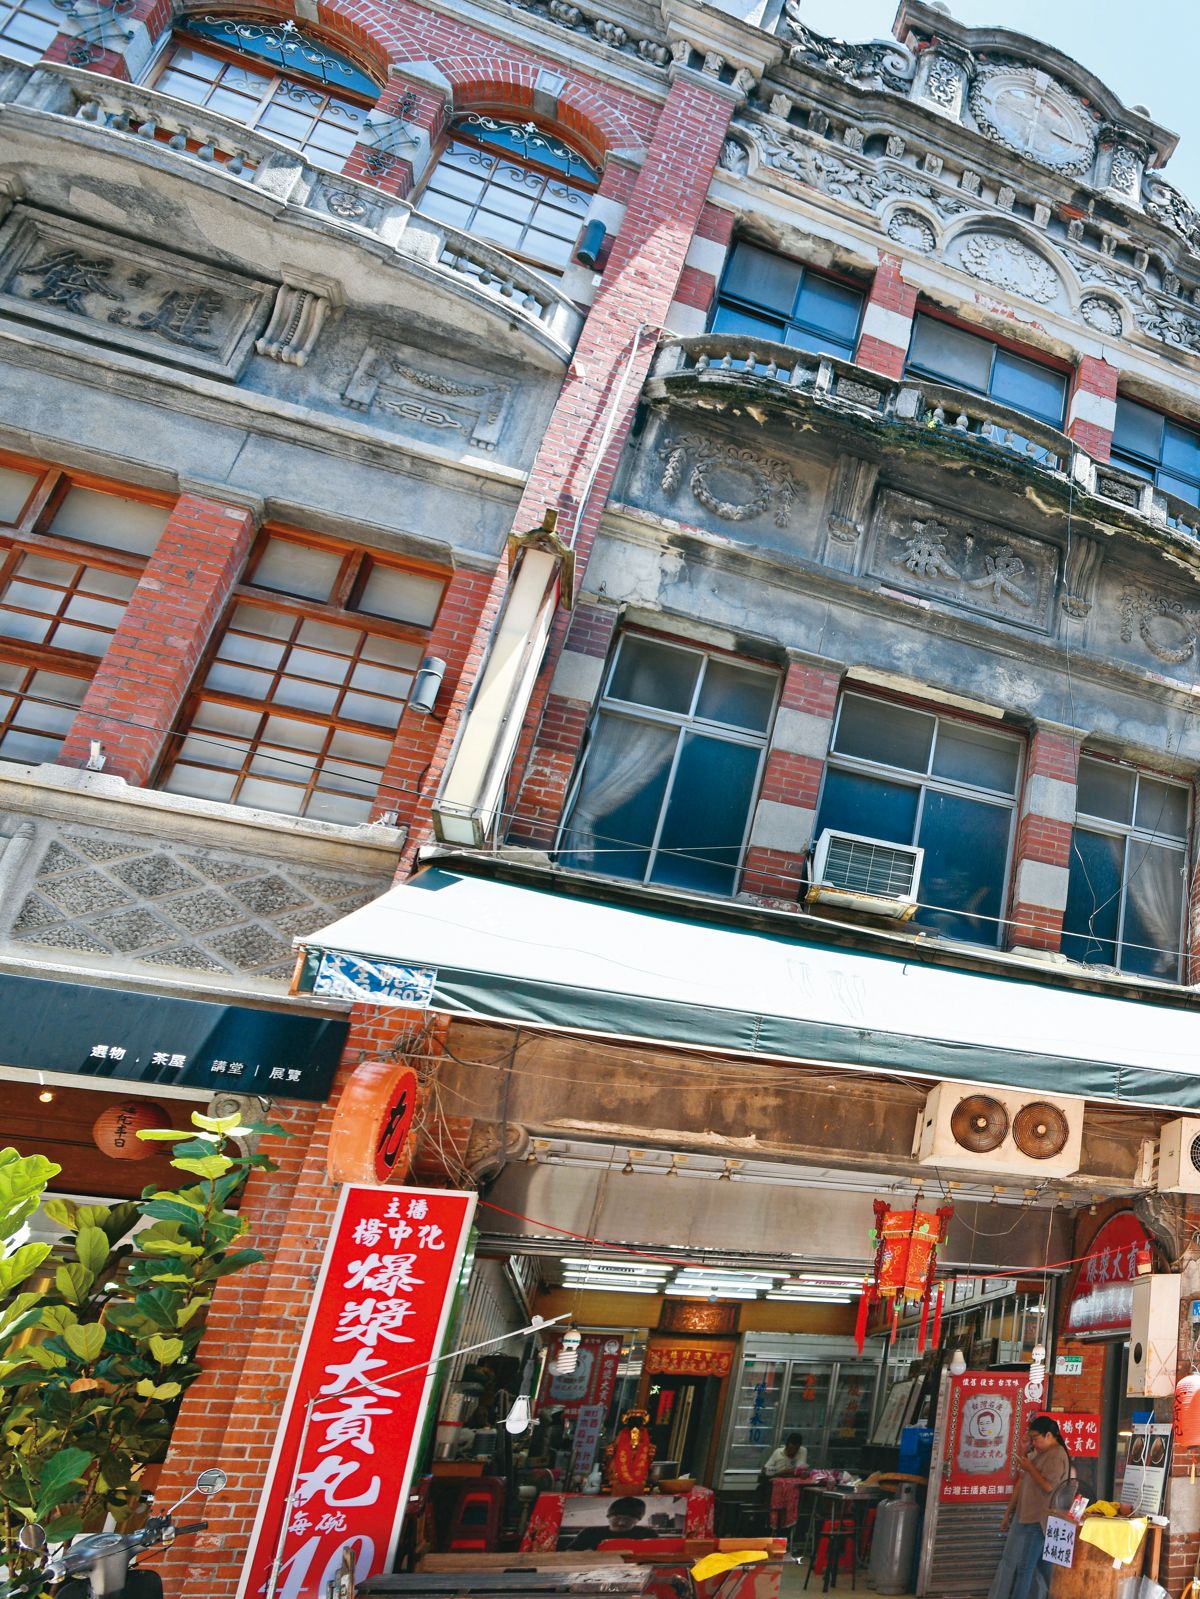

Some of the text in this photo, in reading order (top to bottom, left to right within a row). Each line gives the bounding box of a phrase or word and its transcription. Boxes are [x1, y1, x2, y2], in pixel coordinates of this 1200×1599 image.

[89, 1044, 302, 1082] 選物 茶屋 講堂 展覽
[376, 1089, 407, 1168] 丸
[383, 1197, 429, 1219] 主播
[352, 1218, 446, 1250] 楊中化
[1065, 1363, 1079, 1372] 131
[1056, 1418, 1098, 1434] 楊中化
[288, 1511, 347, 1536] 每碗
